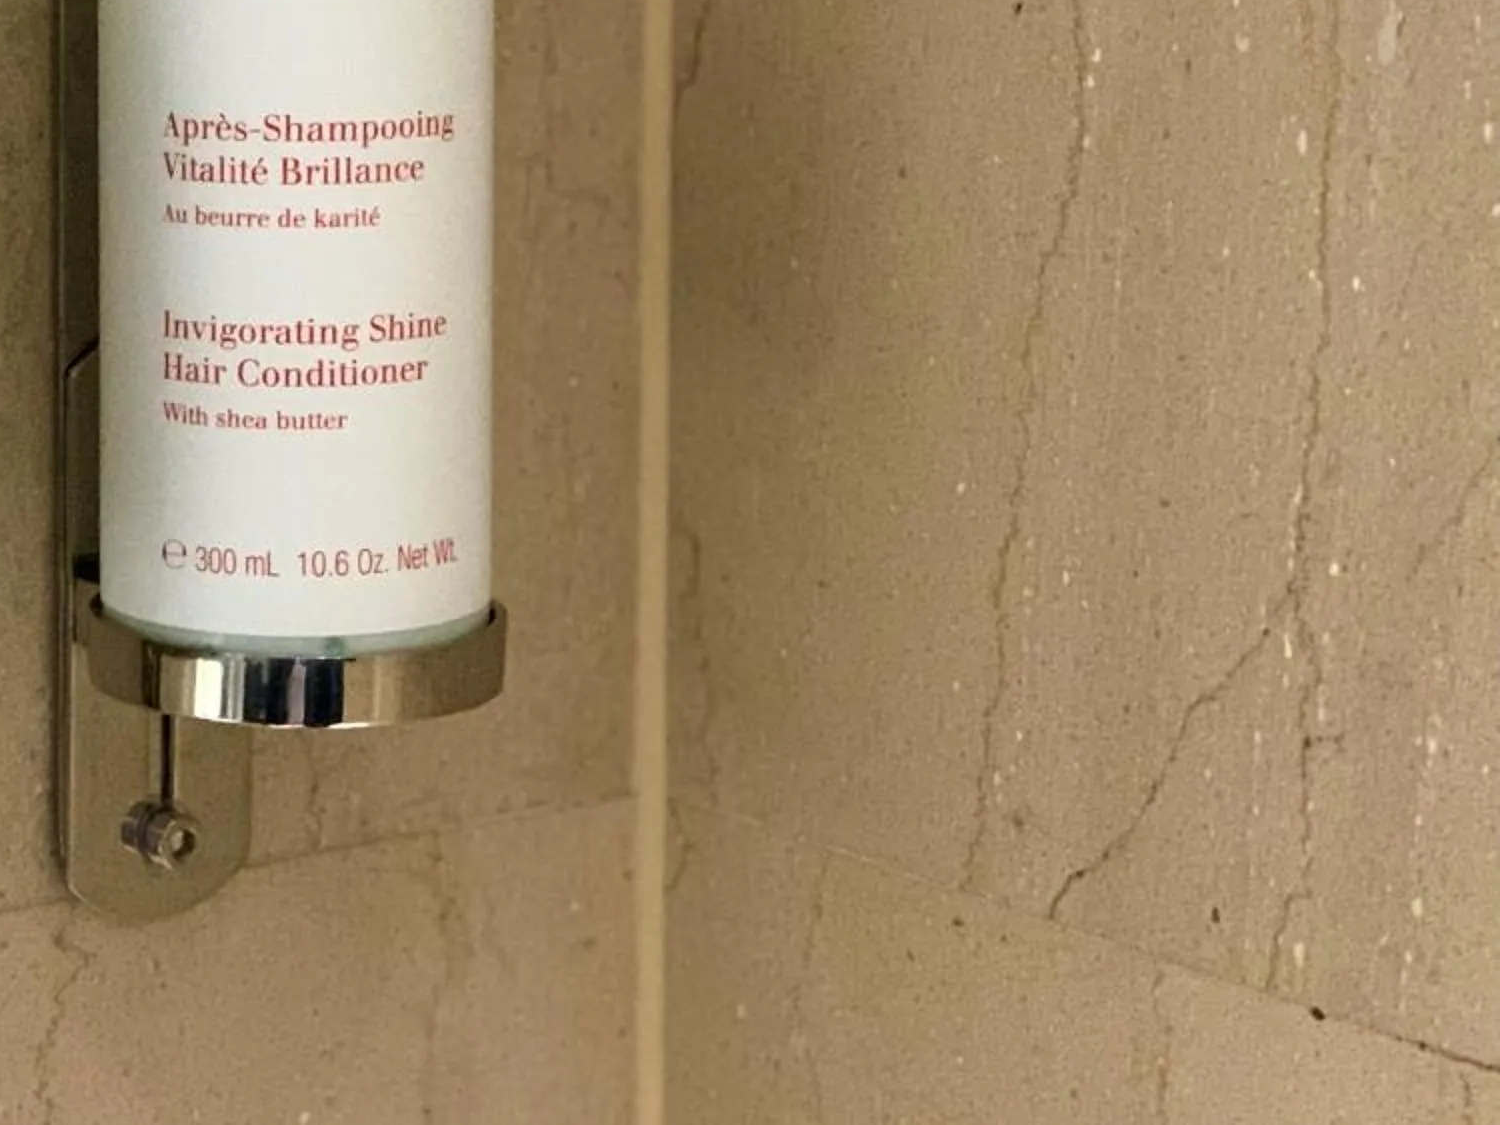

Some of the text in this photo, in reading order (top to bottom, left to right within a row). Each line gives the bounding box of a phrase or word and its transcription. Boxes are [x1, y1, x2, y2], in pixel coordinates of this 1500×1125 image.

[163, 111, 454, 148] Après-Shampooing
[163, 152, 426, 186] Vitalité Brillance
[163, 204, 381, 228] Au beurre de karité
[164, 309, 448, 351] Invigorating Shine
[163, 352, 429, 388] Hair Conditioner
[163, 401, 349, 431] With shea butter
[195, 547, 236, 574] 300
[245, 551, 279, 577] mL
[298, 550, 349, 577] 10.6
[397, 545, 428, 571] Net
